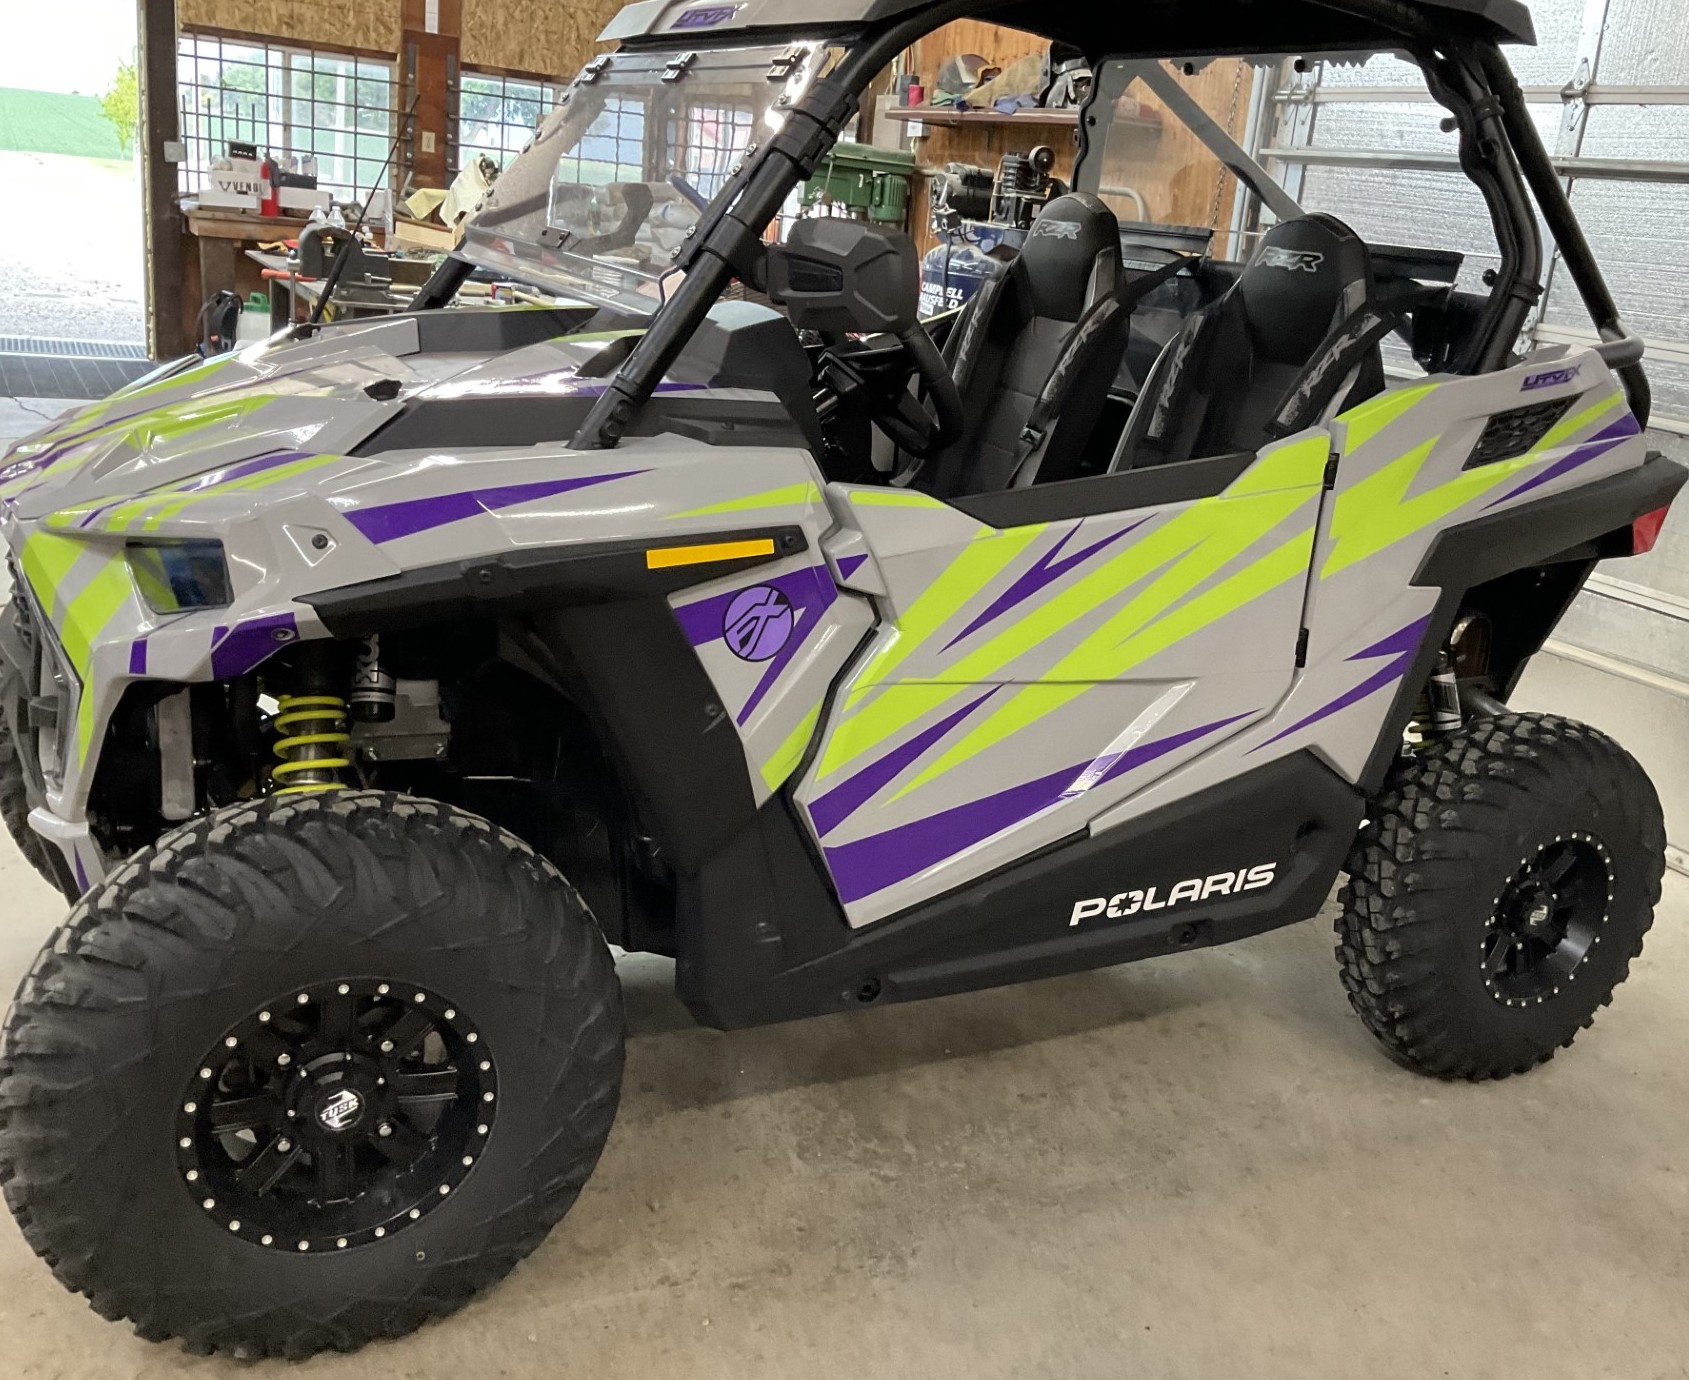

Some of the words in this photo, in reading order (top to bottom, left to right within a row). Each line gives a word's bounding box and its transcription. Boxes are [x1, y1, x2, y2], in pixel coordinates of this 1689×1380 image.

[1033, 218, 1082, 240] RZR
[1255, 246, 1325, 273] RZR
[1068, 861, 1278, 927] POLARIS
[320, 1097, 359, 1121] TUSK
